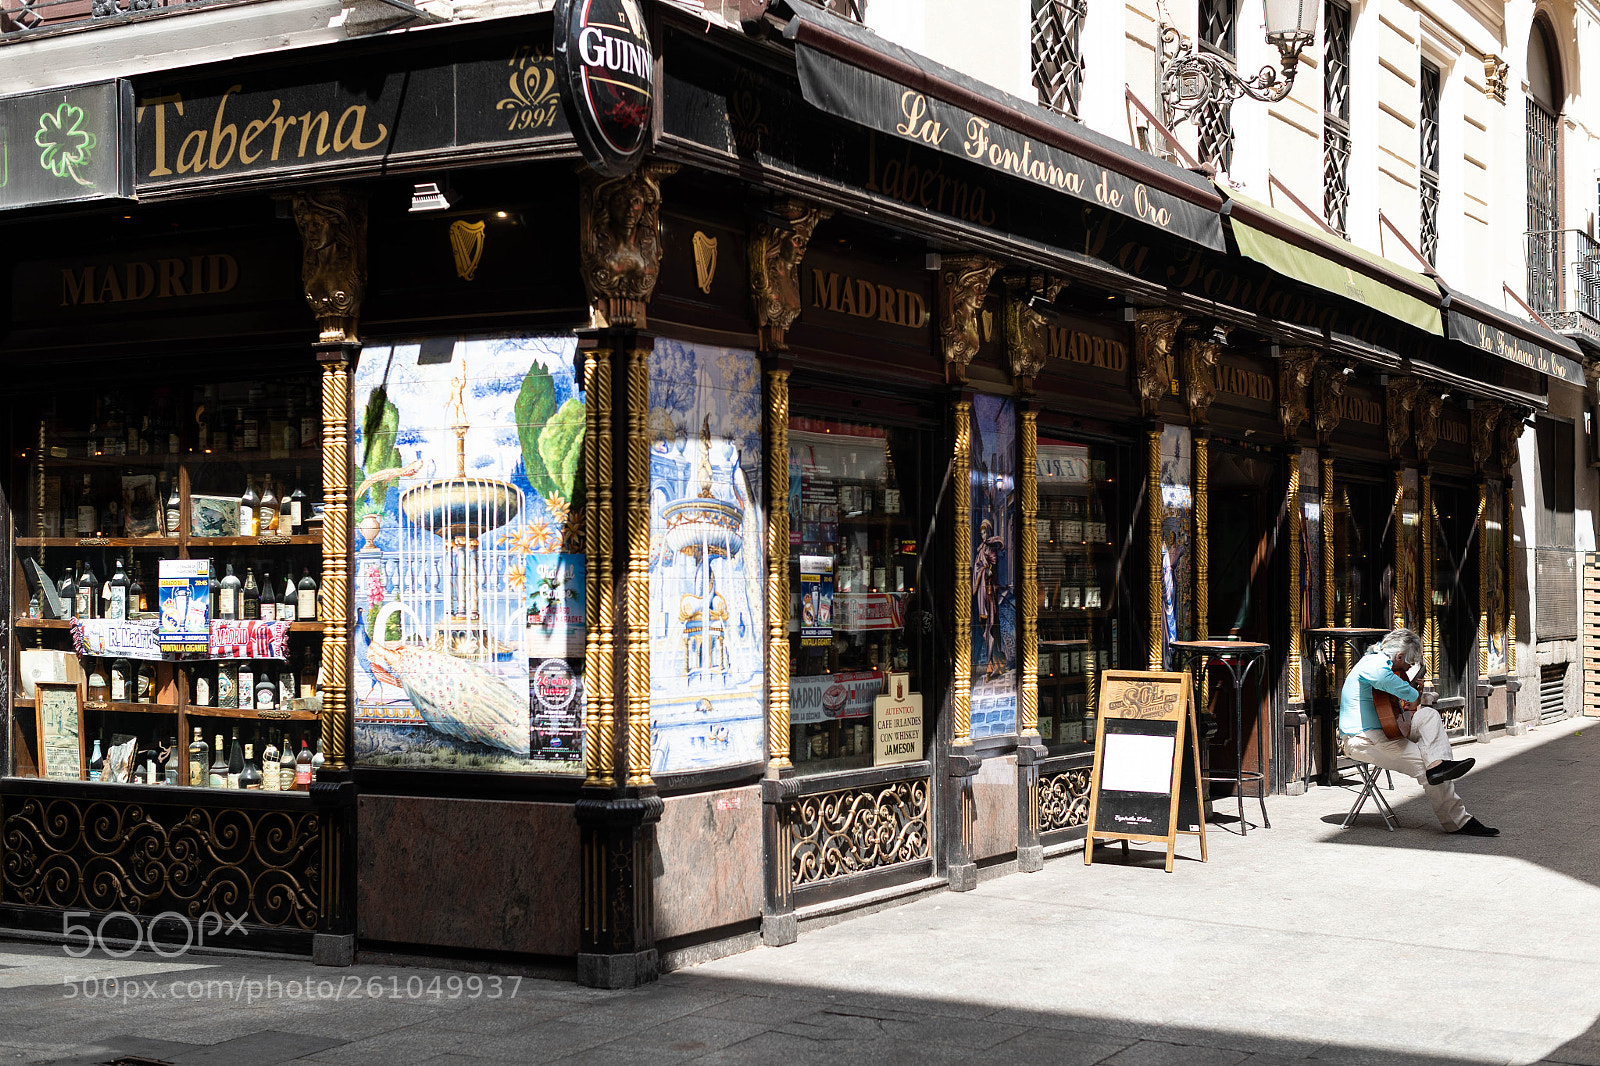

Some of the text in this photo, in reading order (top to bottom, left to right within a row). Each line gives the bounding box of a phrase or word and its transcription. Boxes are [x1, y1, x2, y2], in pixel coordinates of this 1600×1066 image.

[506, 105, 557, 131] 1994
[138, 84, 388, 177] Taberna
[897, 90, 1172, 226] La Fontana de Oro
[865, 130, 995, 227] Taberna
[60, 253, 240, 306] MADRID
[812, 268, 926, 329] MADRID
[1047, 324, 1127, 372] MADRID
[1478, 322, 1493, 352] La
[1497, 330, 1536, 367] Fontana
[1538, 348, 1549, 372] de
[1551, 352, 1567, 378] Oro
[1215, 364, 1274, 401] MADRID
[122, 627, 154, 649] Madrid
[160, 644, 207, 652] PANTALLA GIGANTE
[216, 627, 249, 647] MADRID
[801, 638, 817, 646] PANTALLA
[537, 676, 573, 686] 26 años
[540, 685, 570, 697] juntos
[885, 706, 915, 715] AUTENTICO
[878, 717, 922, 730] CAFE IRLANDES
[880, 730, 920, 743] CON WHISKEY
[885, 742, 916, 756] JAMESON
